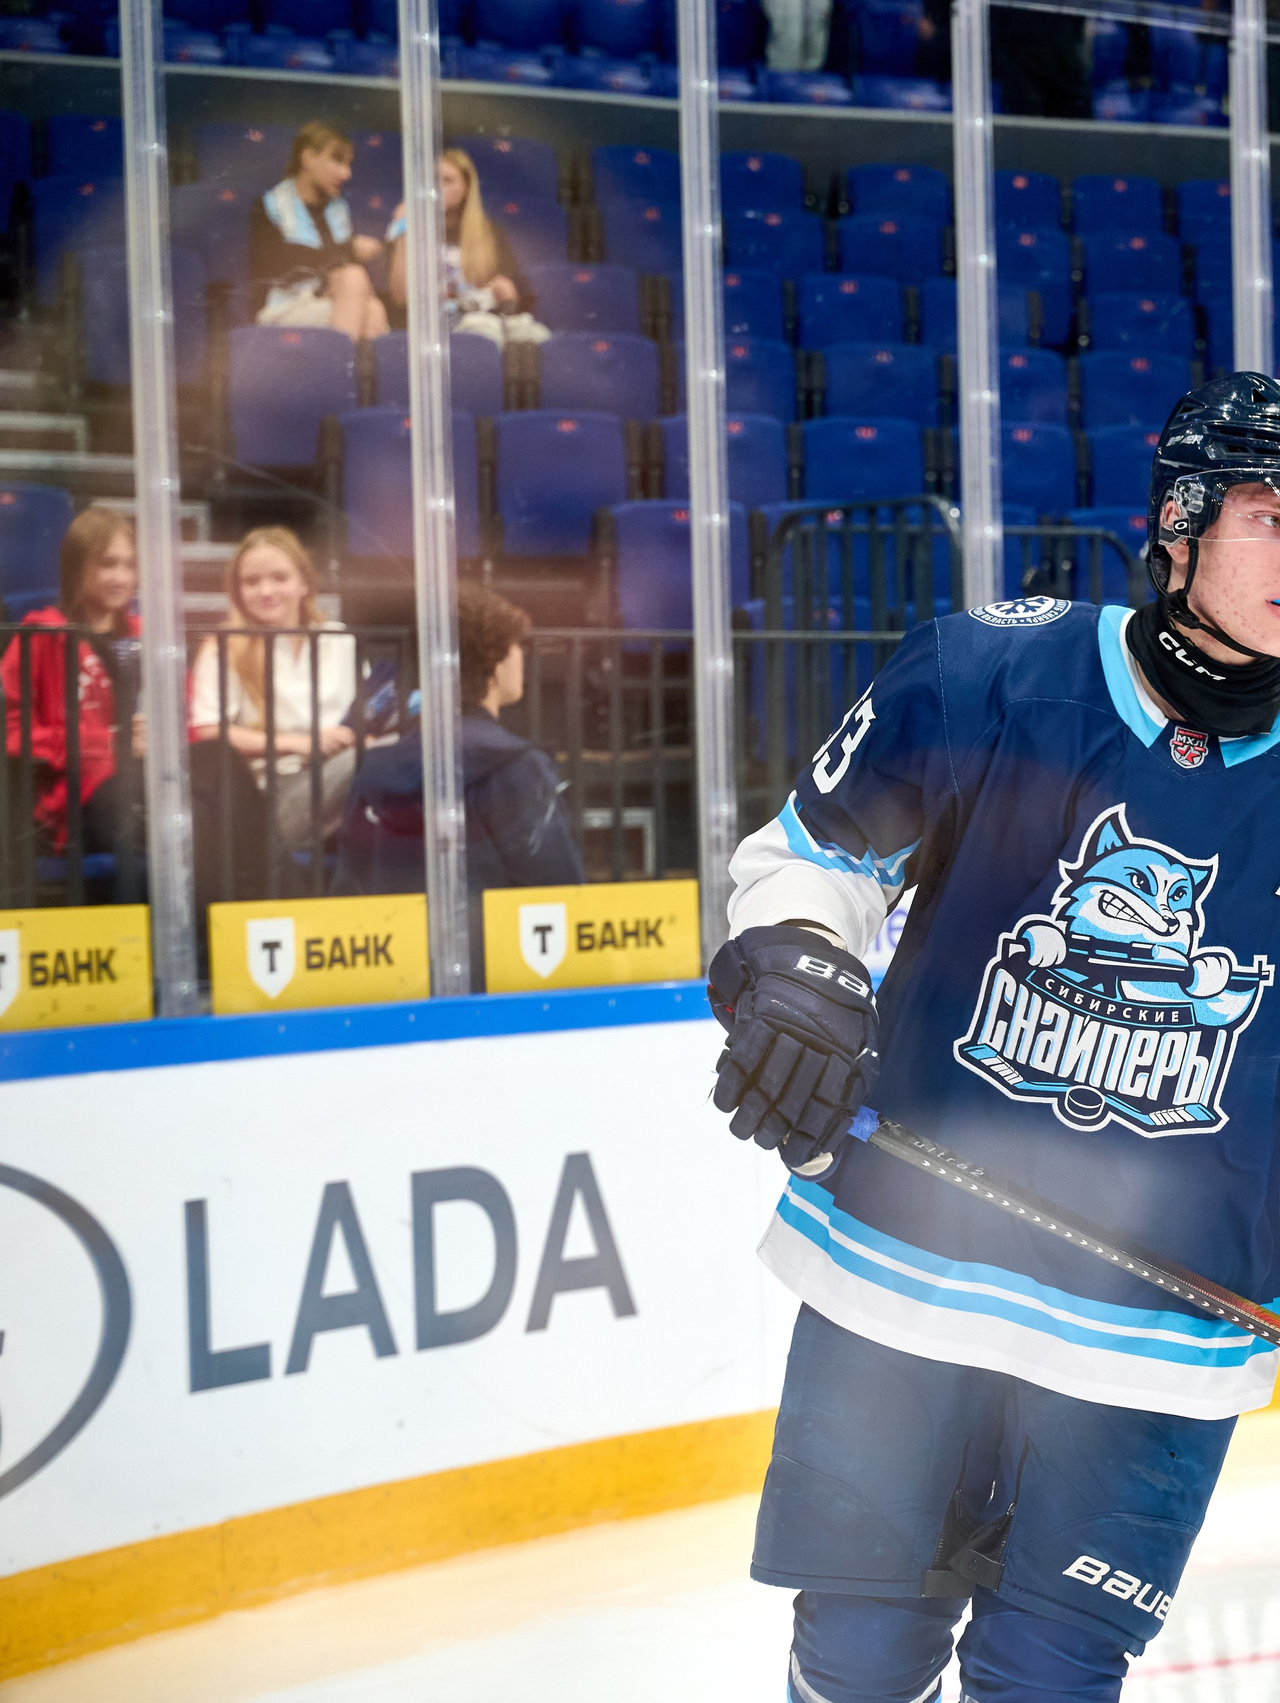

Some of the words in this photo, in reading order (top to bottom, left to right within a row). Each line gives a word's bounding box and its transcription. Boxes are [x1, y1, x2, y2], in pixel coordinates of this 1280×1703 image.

[812, 681, 877, 794] 3
[305, 933, 394, 970] БАНК
[576, 917, 666, 952] БАНК
[29, 948, 117, 987] БАНК
[1045, 977, 1181, 1024] СИБИРСКИЕ
[184, 1150, 639, 1395] LADA
